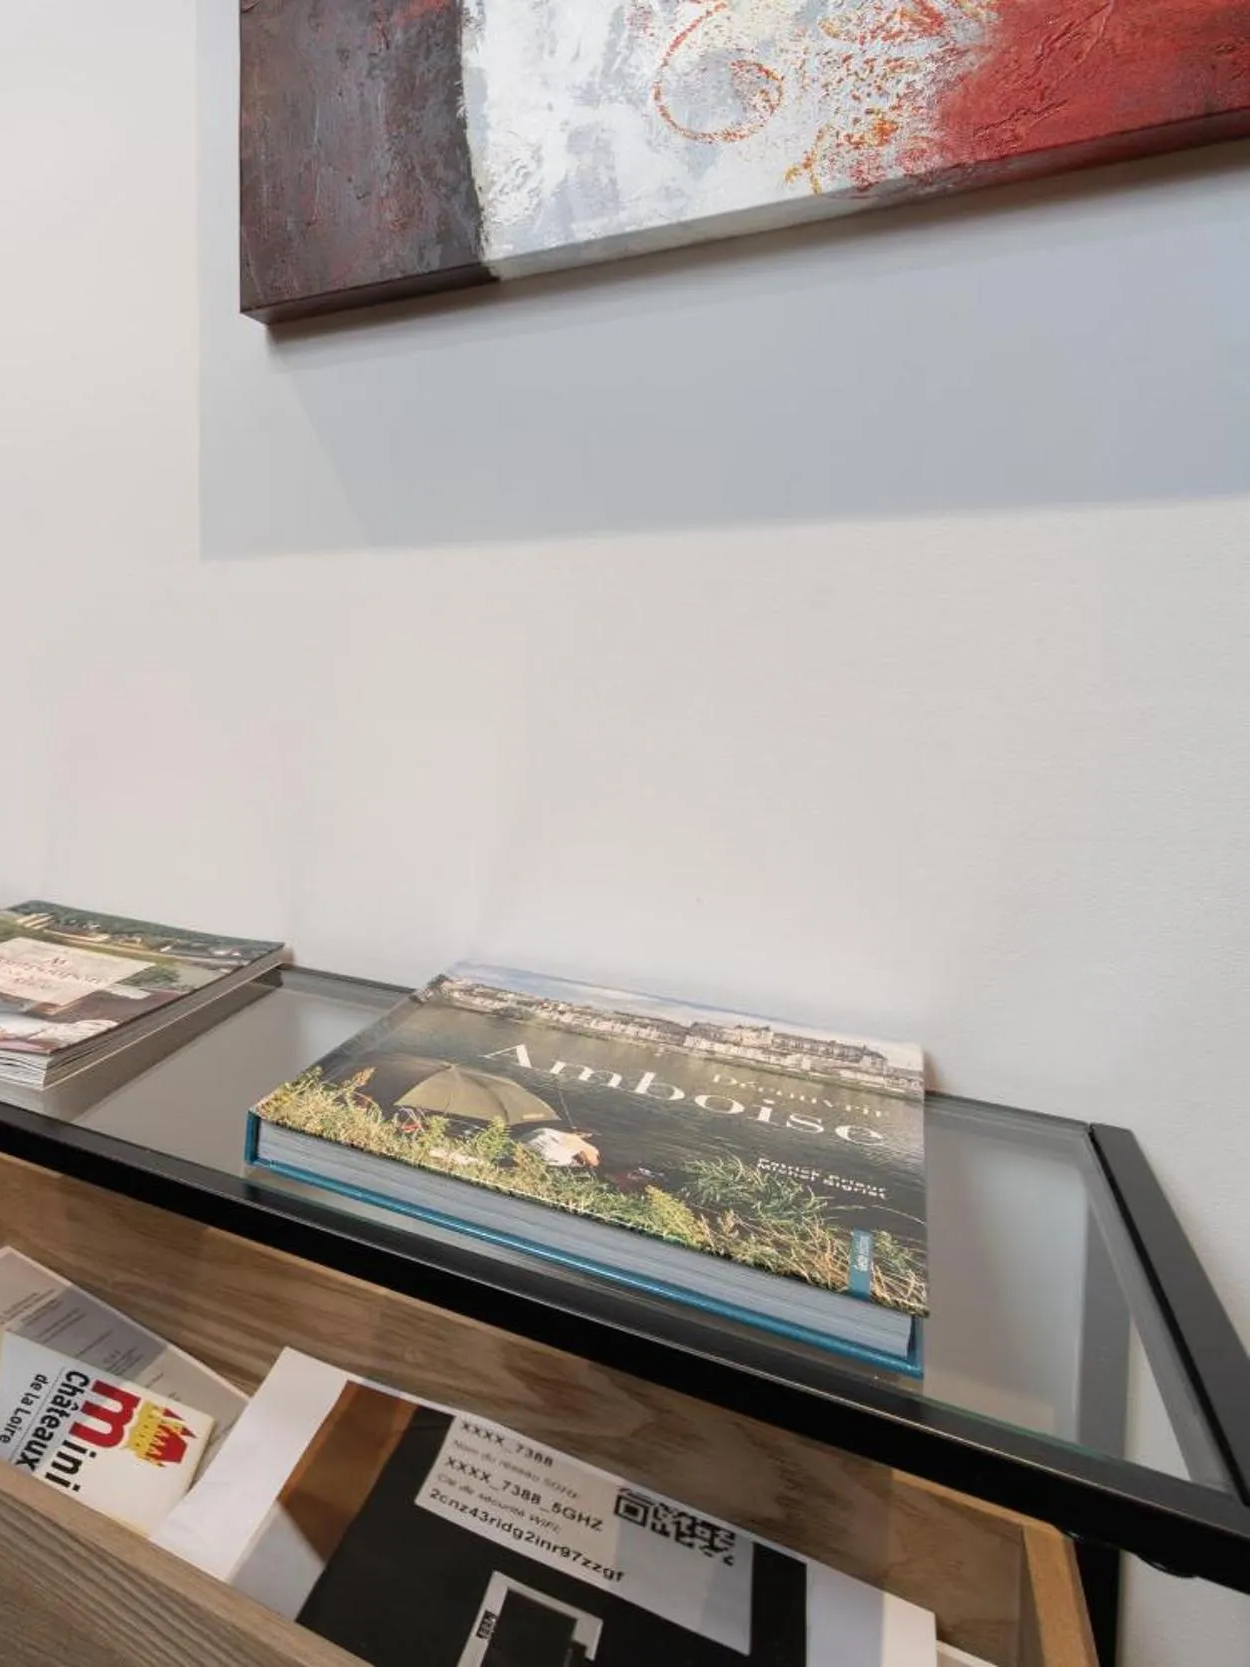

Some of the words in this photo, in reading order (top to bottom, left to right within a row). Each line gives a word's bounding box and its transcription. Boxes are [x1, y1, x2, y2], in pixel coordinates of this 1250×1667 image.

[481, 1043, 886, 1146] Amboise
[14, 1370, 90, 1472] Châteaux
[20, 1392, 41, 1406] la
[30, 1373, 49, 1392] de
[444, 1455, 604, 1533] XXXX_7388_5GHZ
